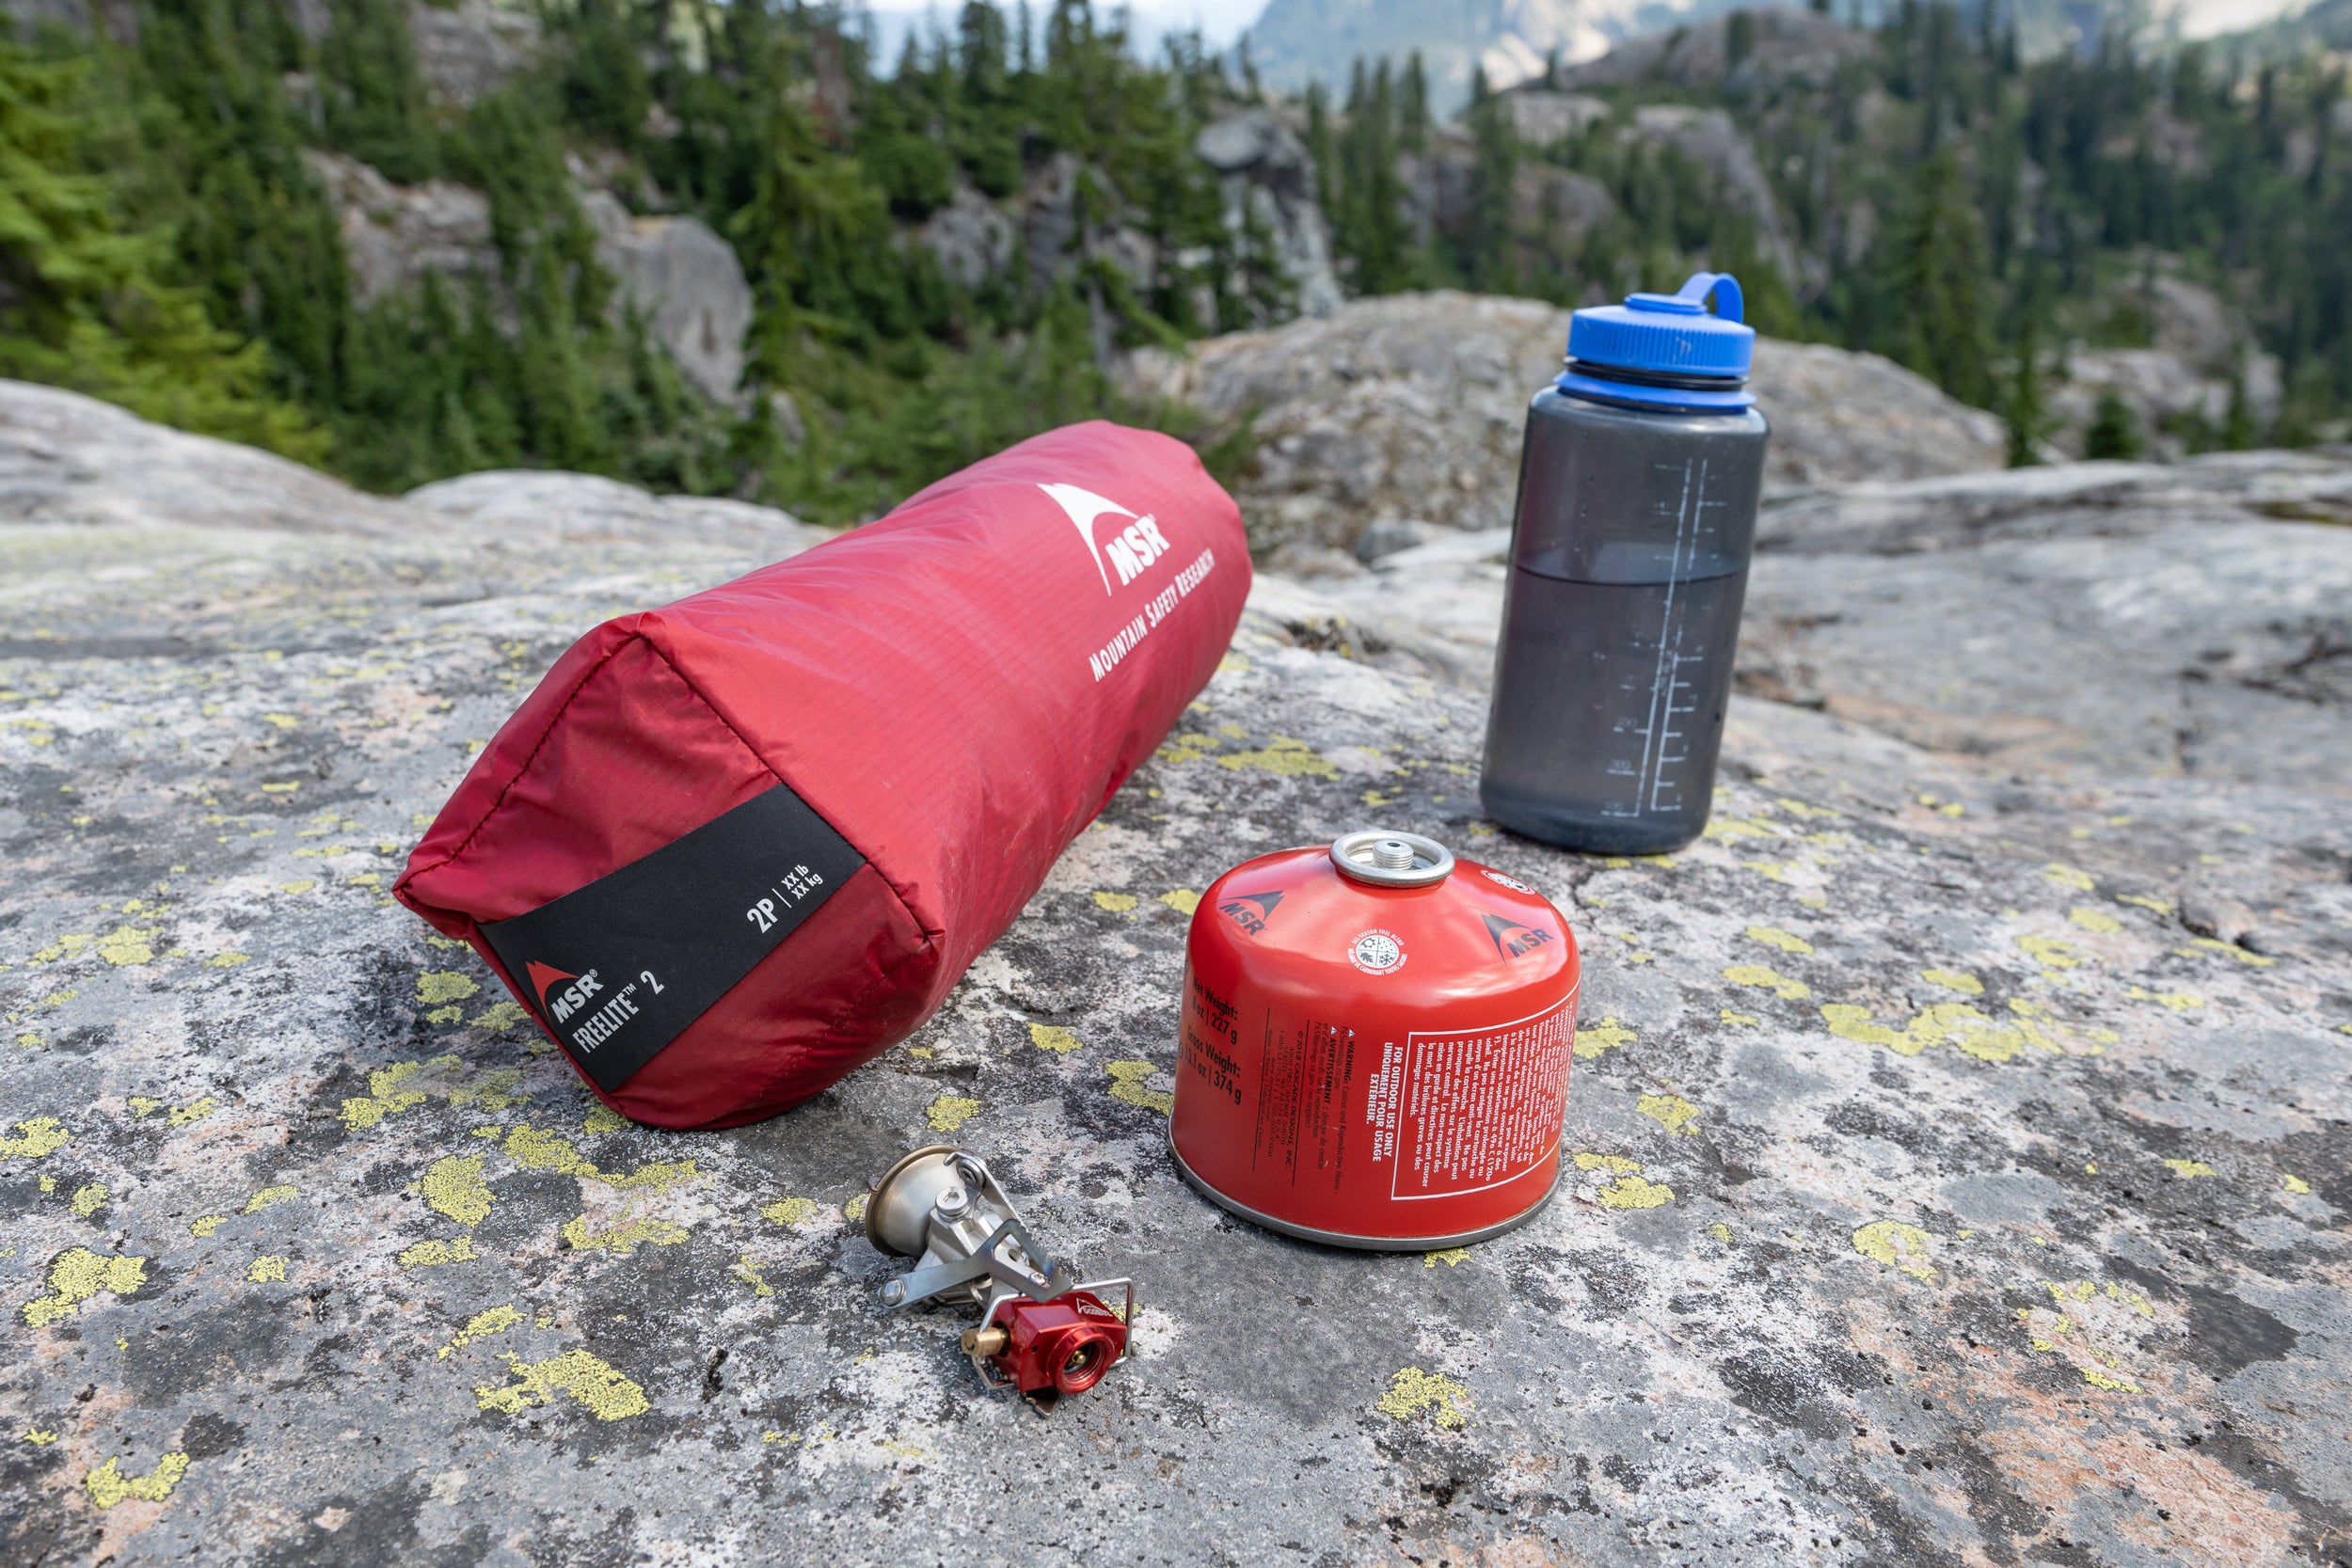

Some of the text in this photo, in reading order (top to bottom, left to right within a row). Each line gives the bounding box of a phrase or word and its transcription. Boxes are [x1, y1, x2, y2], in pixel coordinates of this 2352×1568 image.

[1104, 515, 1170, 586] MSR
[1089, 547, 1216, 683] MOUNTAIN SAFETY RESEARCH
[781, 863, 809, 891] XX lb
[790, 873, 823, 900] XX kg
[746, 897, 778, 934] 2P
[1219, 902, 1266, 936] MSR
[1507, 927, 1554, 958] MSR
[640, 970, 664, 995] 2
[1193, 974, 1238, 1022] Net Weight:
[1211, 1012, 1230, 1035] 227
[1231, 1029, 1237, 1045] g
[1187, 1024, 1203, 1053] Gross
[1206, 1041, 1241, 1079] Weight:
[1424, 1052, 1433, 1069] mort,
[1437, 1042, 1445, 1062] mises
[1454, 1041, 1464, 1076] provoquer
[1465, 1040, 1473, 1065] remplir
[1485, 1037, 1493, 1057] soleil.
[1492, 1049, 1502, 1069] Éviter
[1324, 1037, 1336, 1103] AVERTISSEMENT
[1409, 1043, 1426, 1117] dommages matériels.
[1424, 1071, 1433, 1084] des
[1436, 1063, 1441, 1072] en
[1483, 1061, 1490, 1071] Ne
[1198, 1063, 1206, 1079] oz
[1214, 1070, 1233, 1097] 374
[1234, 1088, 1242, 1106] g
[1366, 1073, 1381, 1124] EXTÉRIEUR.
[1433, 1074, 1441, 1095] garde
[1442, 1072, 1451, 1099] central.
[1454, 1078, 1462, 1090] des
[1460, 1075, 1470, 1112] cartouche.
[1470, 1082, 1479, 1102] écran
[1373, 1042, 1393, 1162] UNIQUEMENT POUR USAGE
[1384, 1047, 1403, 1157] FOR OUTDOOR USE ONLY
[1421, 1085, 1432, 1116] brûlures
[1440, 1103, 1449, 1112] Le
[1451, 1092, 1460, 1113] effets
[1476, 1087, 1486, 1118] protéger
[1485, 1086, 1494, 1124] exposition
[1427, 1105, 1438, 1141] directives
[1435, 1114, 1445, 1157] non-respect
[1465, 1103, 1475, 1140] anti-vent.
[1416, 1145, 1422, 1154] ou
[1443, 1137, 1452, 1168] système
[1463, 1144, 1471, 1155] Ne
[1470, 1130, 1480, 1166] cartouche
[1479, 1126, 1489, 1164] prolongée
[1414, 1157, 1423, 1170] des
[1434, 1159, 1442, 1173] des
[1470, 1168, 1475, 1179] au
[1478, 1166, 1484, 1176] au
